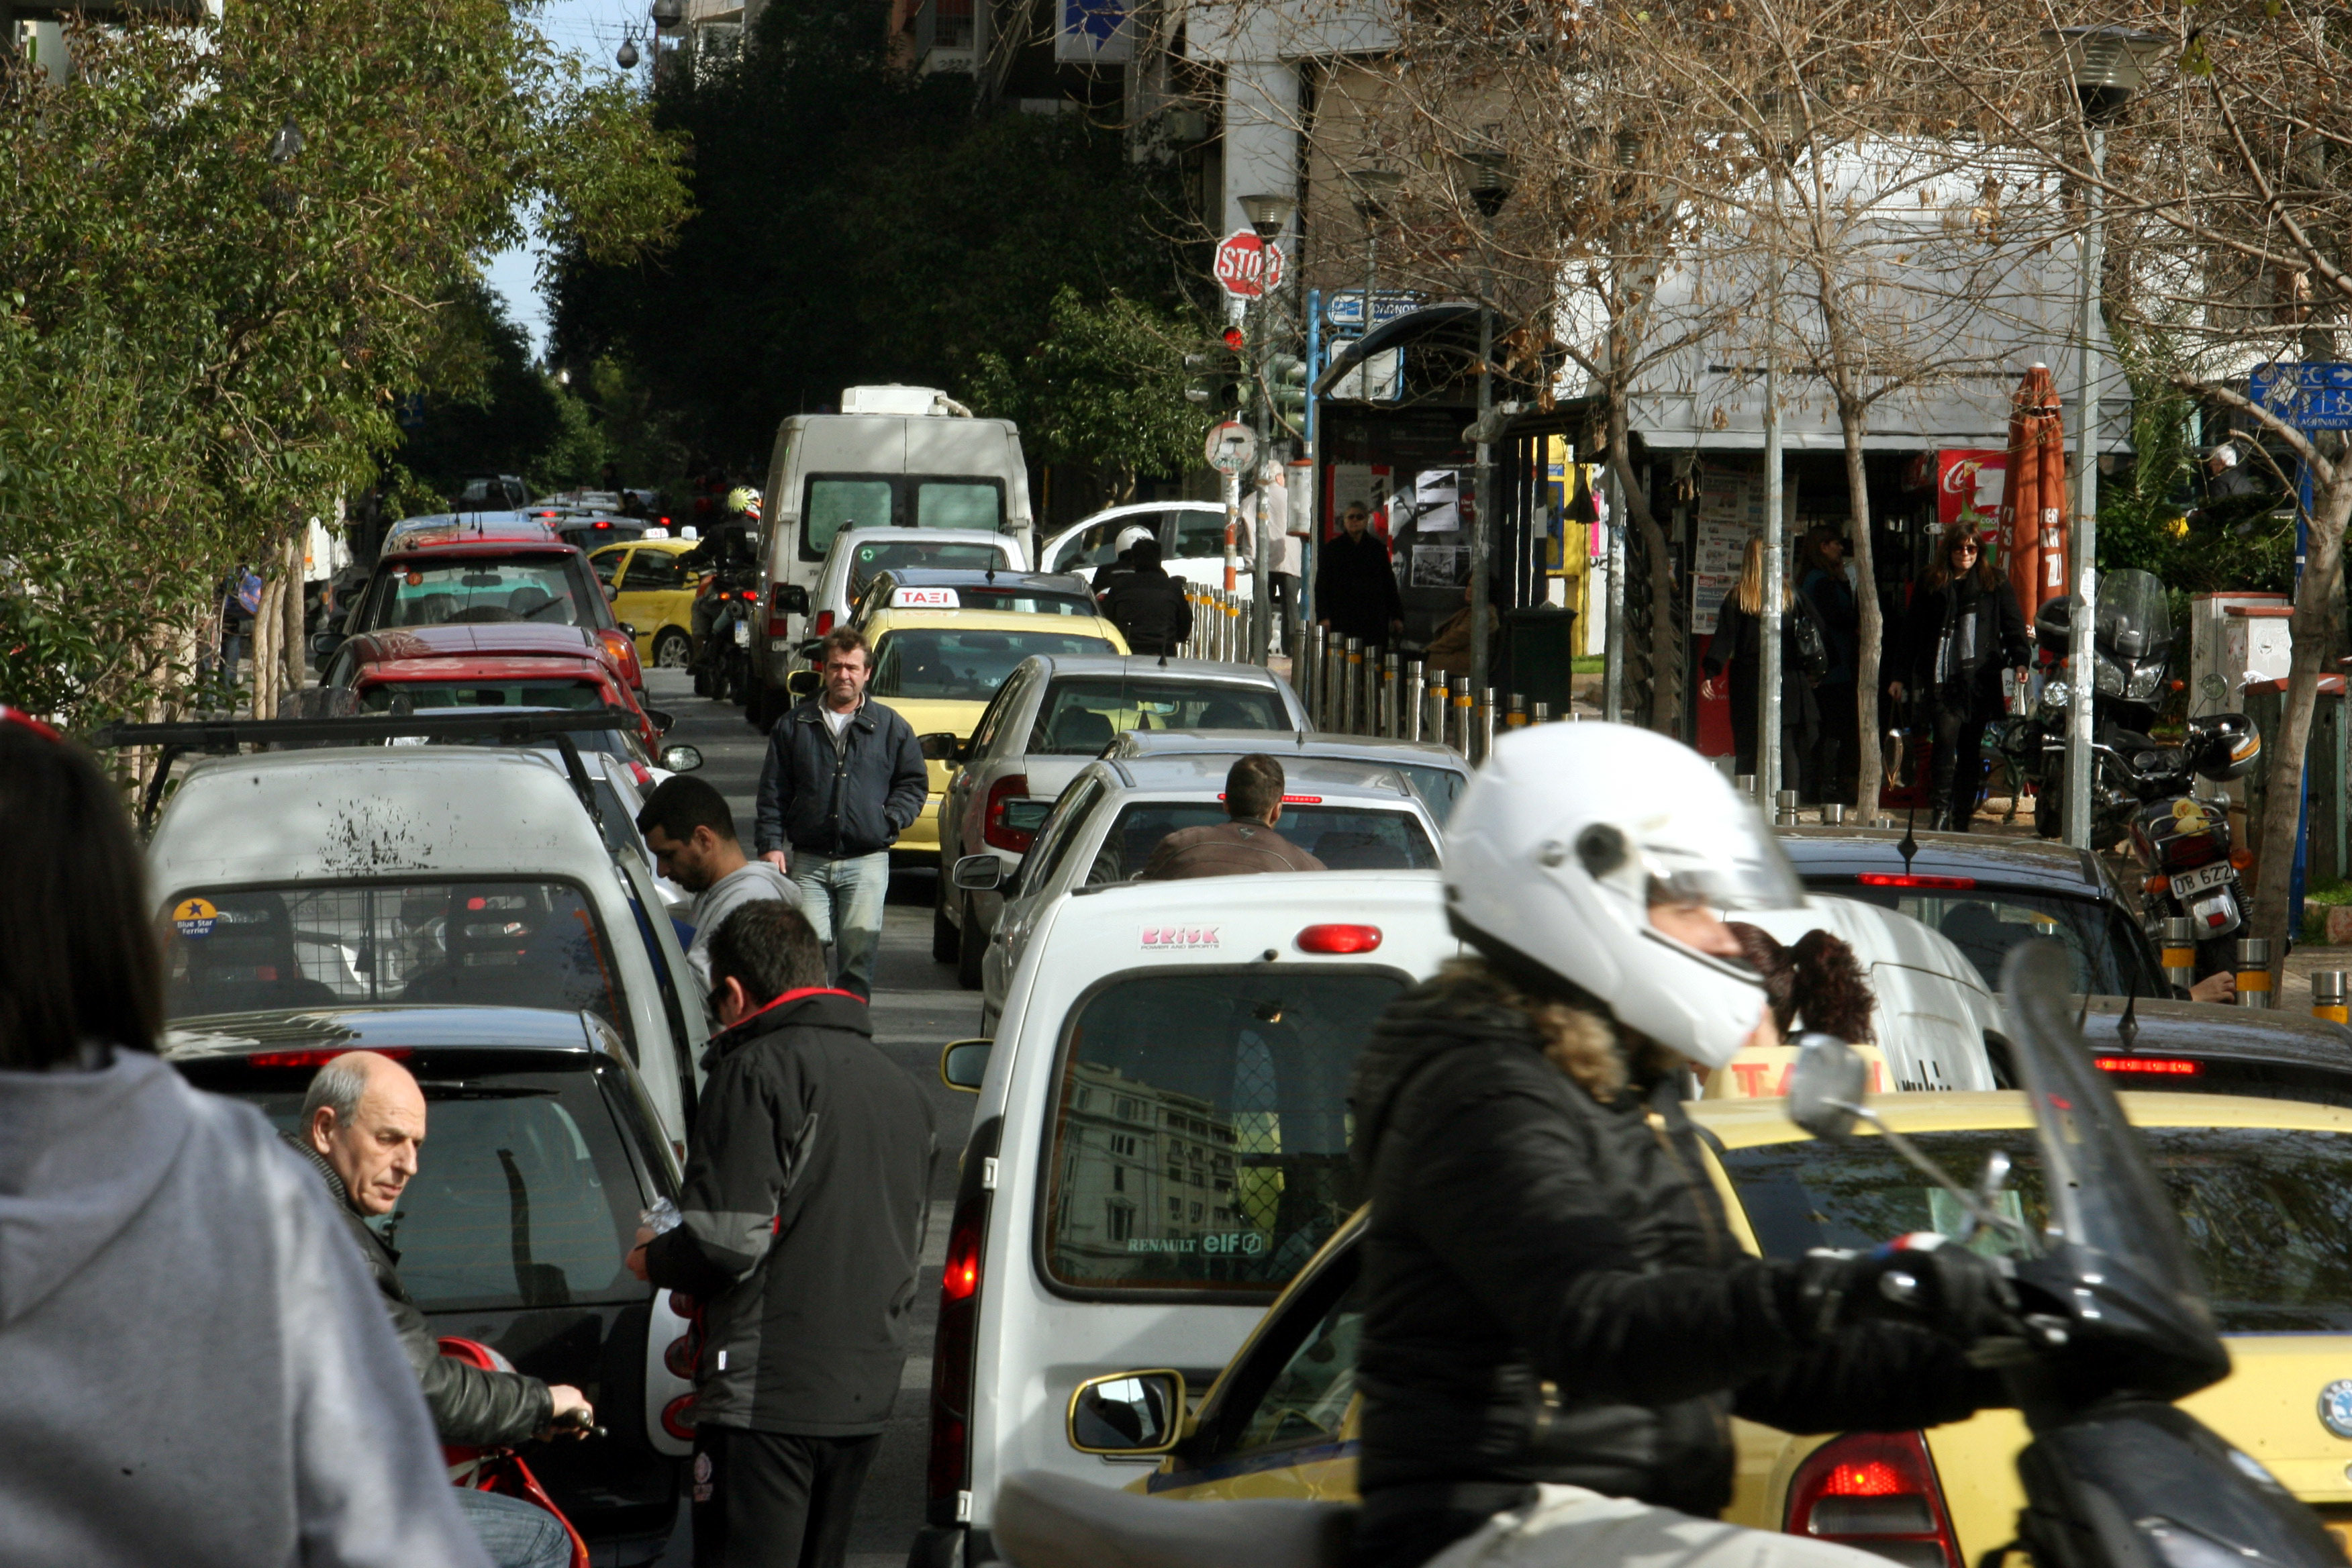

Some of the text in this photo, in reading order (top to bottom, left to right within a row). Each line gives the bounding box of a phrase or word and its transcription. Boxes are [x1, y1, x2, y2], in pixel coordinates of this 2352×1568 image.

[2200, 865, 2231, 885] 622
[177, 919, 213, 929] Blue Star
[182, 926, 209, 936] Ferries
[1730, 1061, 1882, 1098] TI
[1127, 1232, 1240, 1253] RENAULT elf
